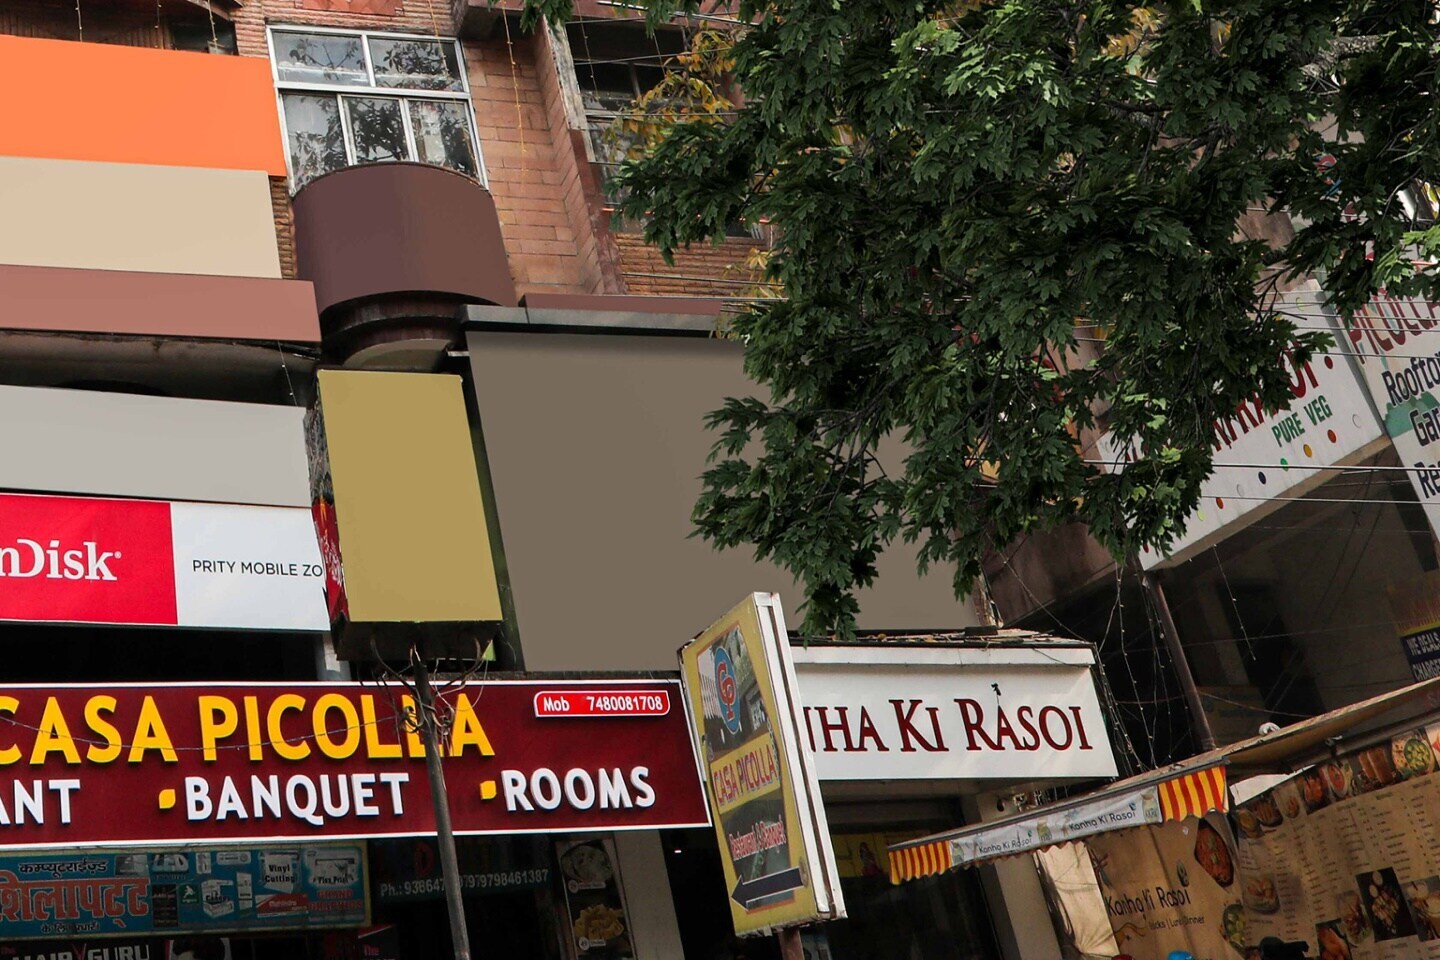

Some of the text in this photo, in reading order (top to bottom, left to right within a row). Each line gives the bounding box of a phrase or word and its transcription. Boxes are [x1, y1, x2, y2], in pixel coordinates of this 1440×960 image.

[1381, 351, 1440, 406] Roofto
[1271, 394, 1333, 448] PURE VEG
[192, 559, 324, 578] PRITY MOBILE ZO
[542, 695, 664, 712] Mob 7480081708
[198, 692, 496, 762] PICOLLA
[953, 697, 1094, 753] RASOI
[713, 742, 777, 807] CASA PICOLLA
[185, 772, 410, 826] BANQUET
[501, 766, 658, 813] ROOMS
[1068, 818, 1098, 833] Kanha
[1098, 814, 1109, 826] Ki
[1109, 809, 1137, 824] Rasoi
[978, 843, 1002, 855] Kanha
[264, 874, 296, 884] Cutting
[268, 863, 291, 875] Vinyl
[1104, 893, 1144, 917] Kanha
[1156, 886, 1192, 909] Rasoi
